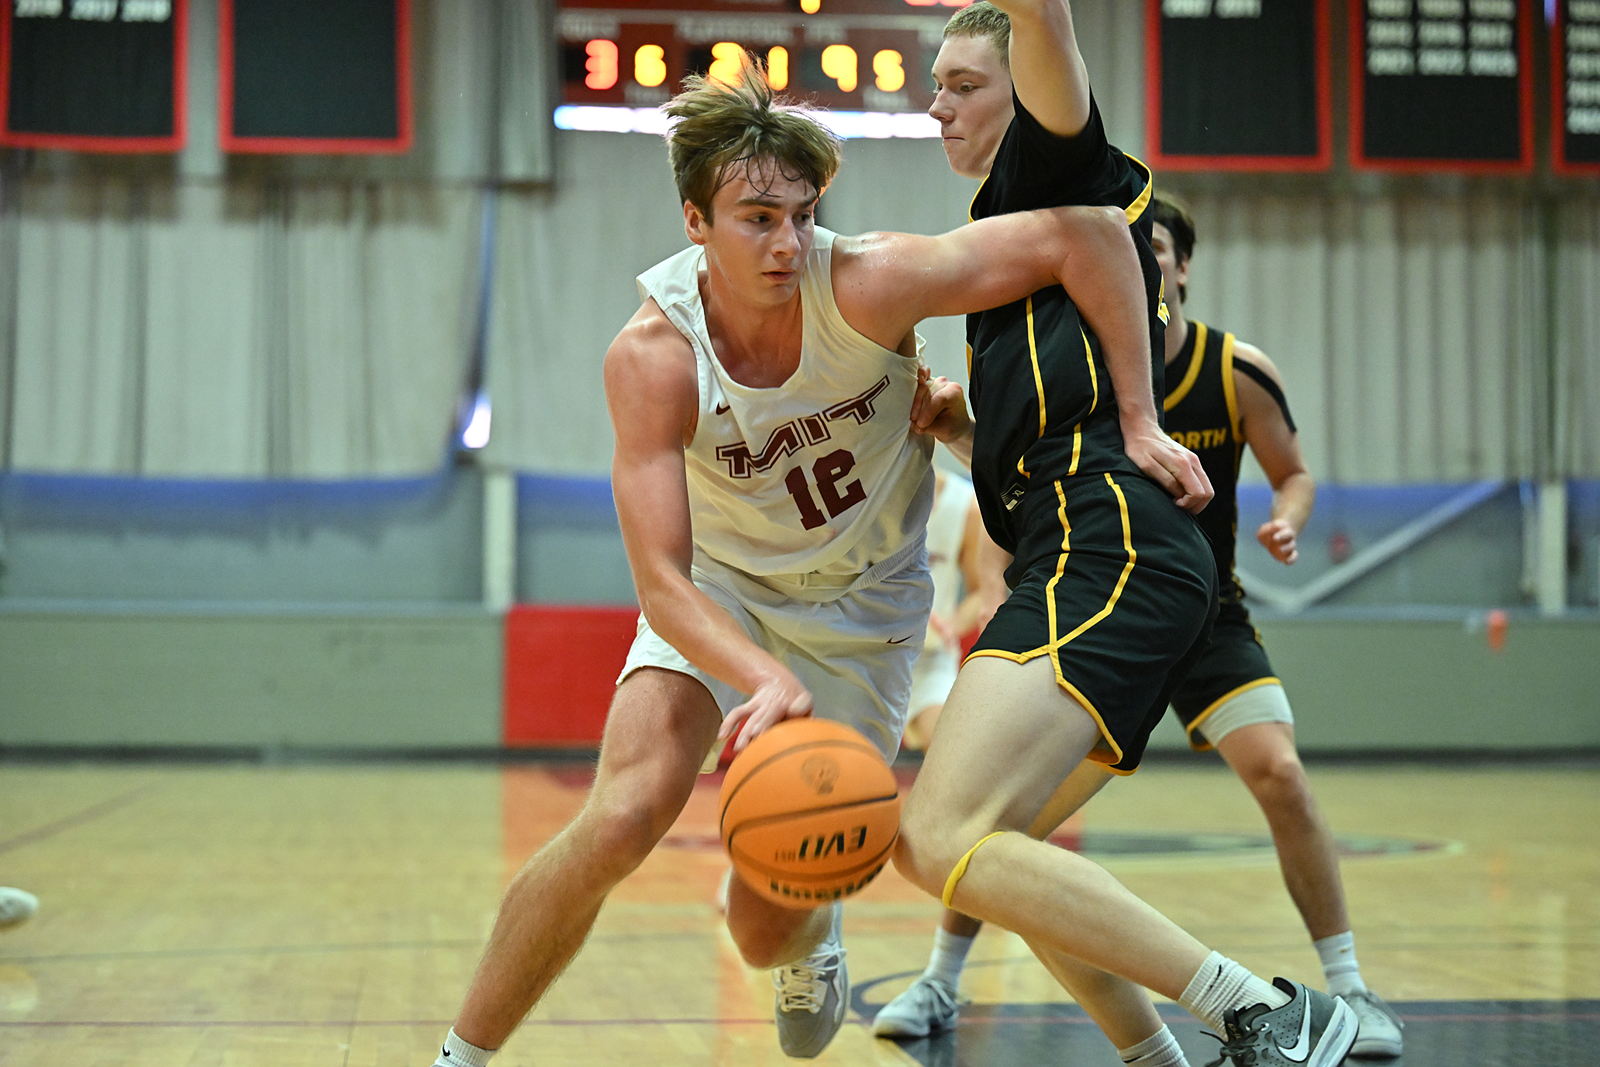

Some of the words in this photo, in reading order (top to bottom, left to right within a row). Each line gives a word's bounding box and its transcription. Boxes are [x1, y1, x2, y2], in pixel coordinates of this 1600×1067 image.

[585, 39, 619, 90] 3
[821, 44, 858, 93] 9
[716, 374, 890, 479] MIT
[784, 448, 867, 531] 12
